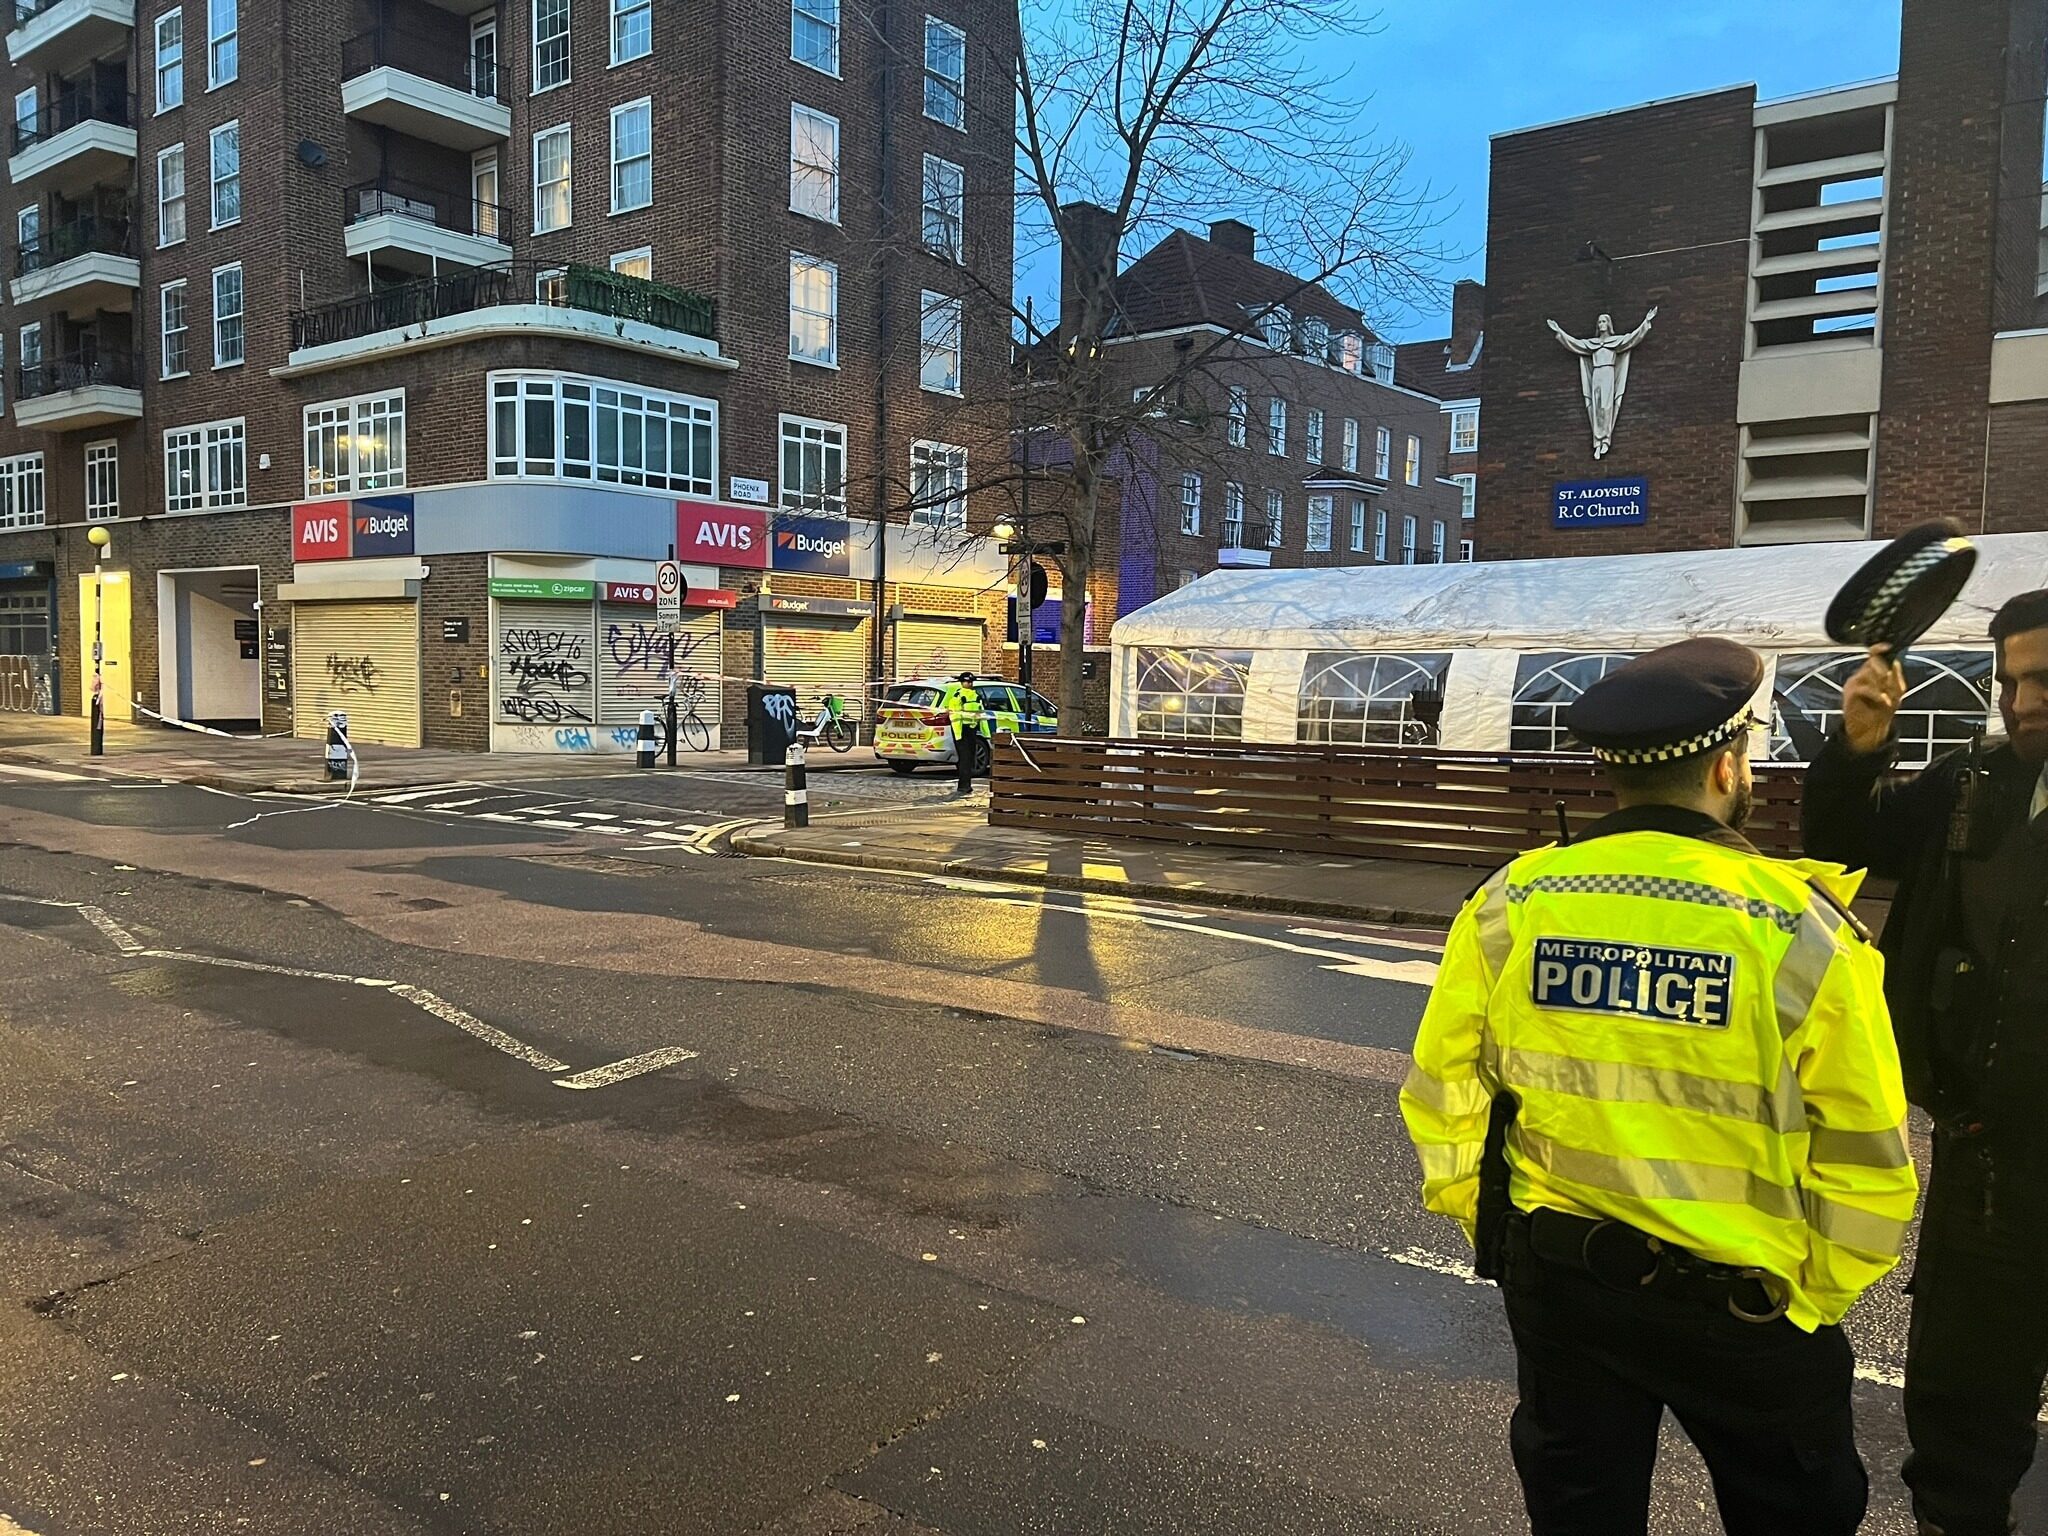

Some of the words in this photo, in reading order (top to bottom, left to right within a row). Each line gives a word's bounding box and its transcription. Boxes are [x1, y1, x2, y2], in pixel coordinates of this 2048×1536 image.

[733, 482, 760, 492] PHOENIX
[1558, 490, 1577, 500] ST.
[1579, 486, 1641, 499] ALOYSIUS
[733, 490, 752, 498] ROAD
[1558, 504, 1584, 519] R.C
[1587, 501, 1640, 517] Church
[302, 518, 339, 544] AVIS
[369, 514, 409, 538] Budget
[695, 521, 752, 550] AVIS
[797, 534, 846, 558] Budget
[661, 572, 676, 585] 20
[563, 585, 586, 593] zipcar
[613, 587, 640, 599] AVIS
[658, 597, 678, 606] ZONE
[782, 599, 809, 612] Budget
[658, 612, 679, 620] Somers
[881, 731, 926, 740] POLICE
[1540, 942, 1728, 974] METROPOLITAN
[1537, 960, 1725, 1022] POLICE
